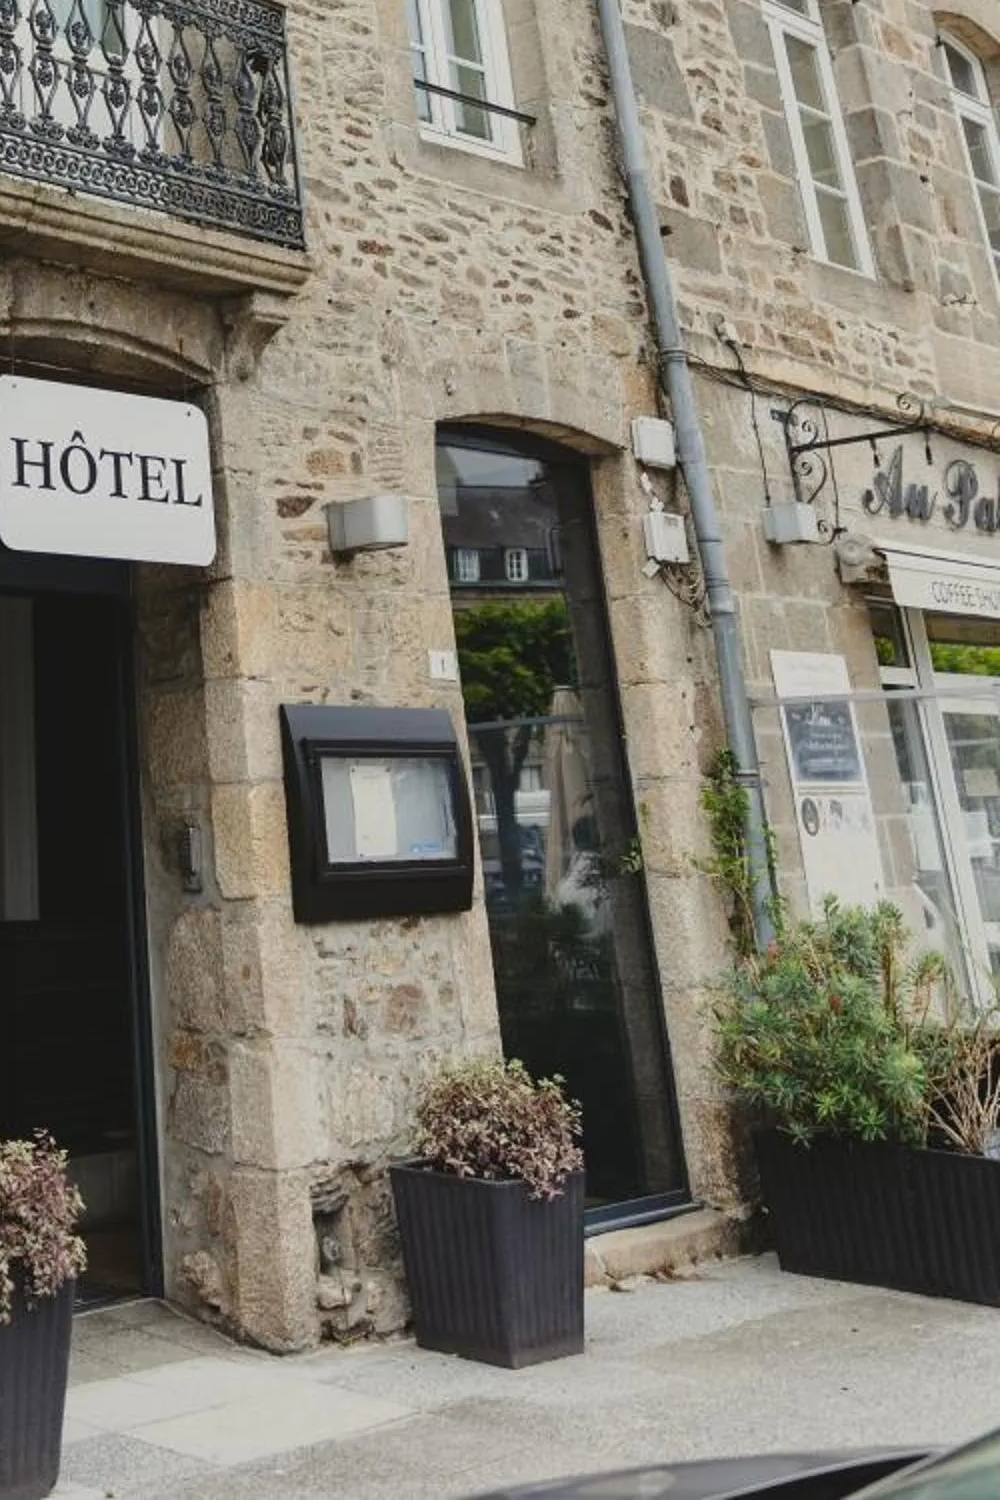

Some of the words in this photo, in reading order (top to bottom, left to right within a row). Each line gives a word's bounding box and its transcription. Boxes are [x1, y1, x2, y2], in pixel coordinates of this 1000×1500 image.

[9, 429, 203, 508] HÔTEL
[862, 444, 939, 520] Au
[943, 459, 1000, 534] Pa
